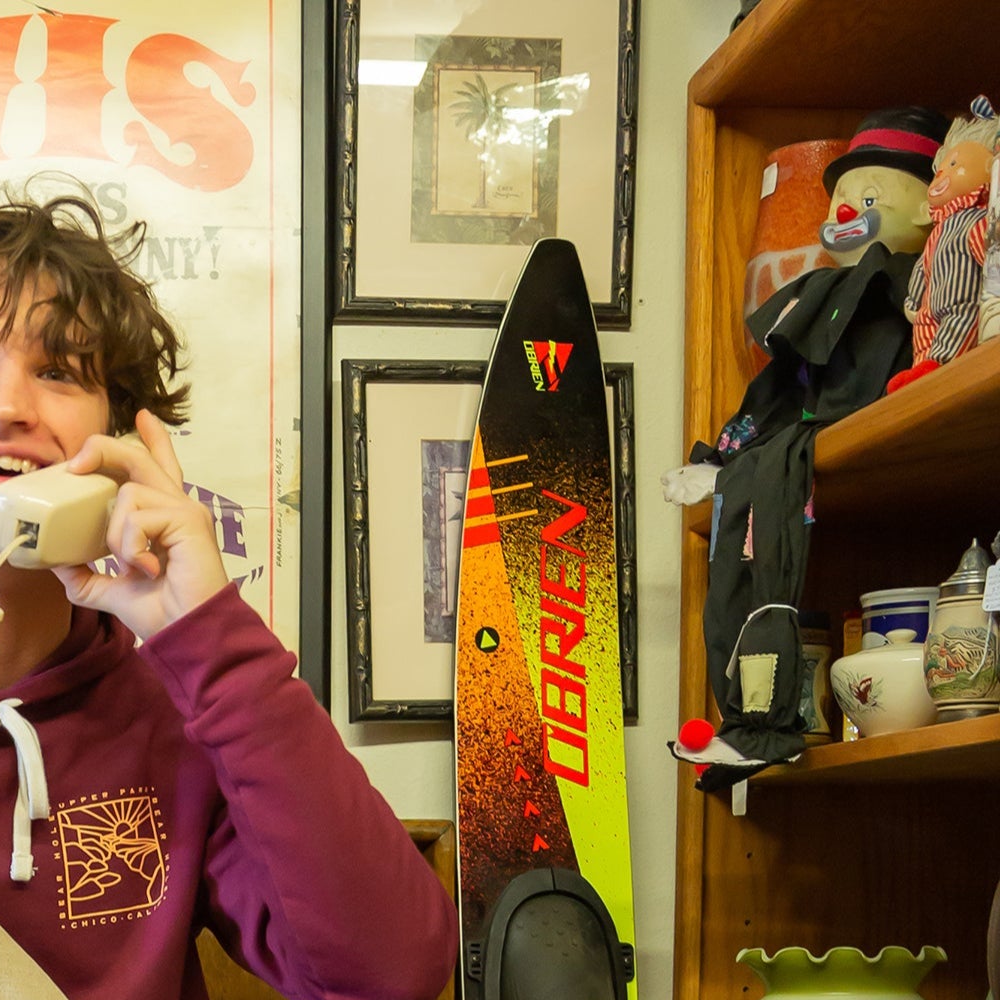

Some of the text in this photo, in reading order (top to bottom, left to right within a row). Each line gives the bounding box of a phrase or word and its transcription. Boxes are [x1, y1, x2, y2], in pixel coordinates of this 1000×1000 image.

[58, 791, 108, 809] UPPER
[152, 797, 167, 840] BEAR
[48, 815, 66, 919] BEAR HOLE
[70, 915, 117, 930] CHICO
